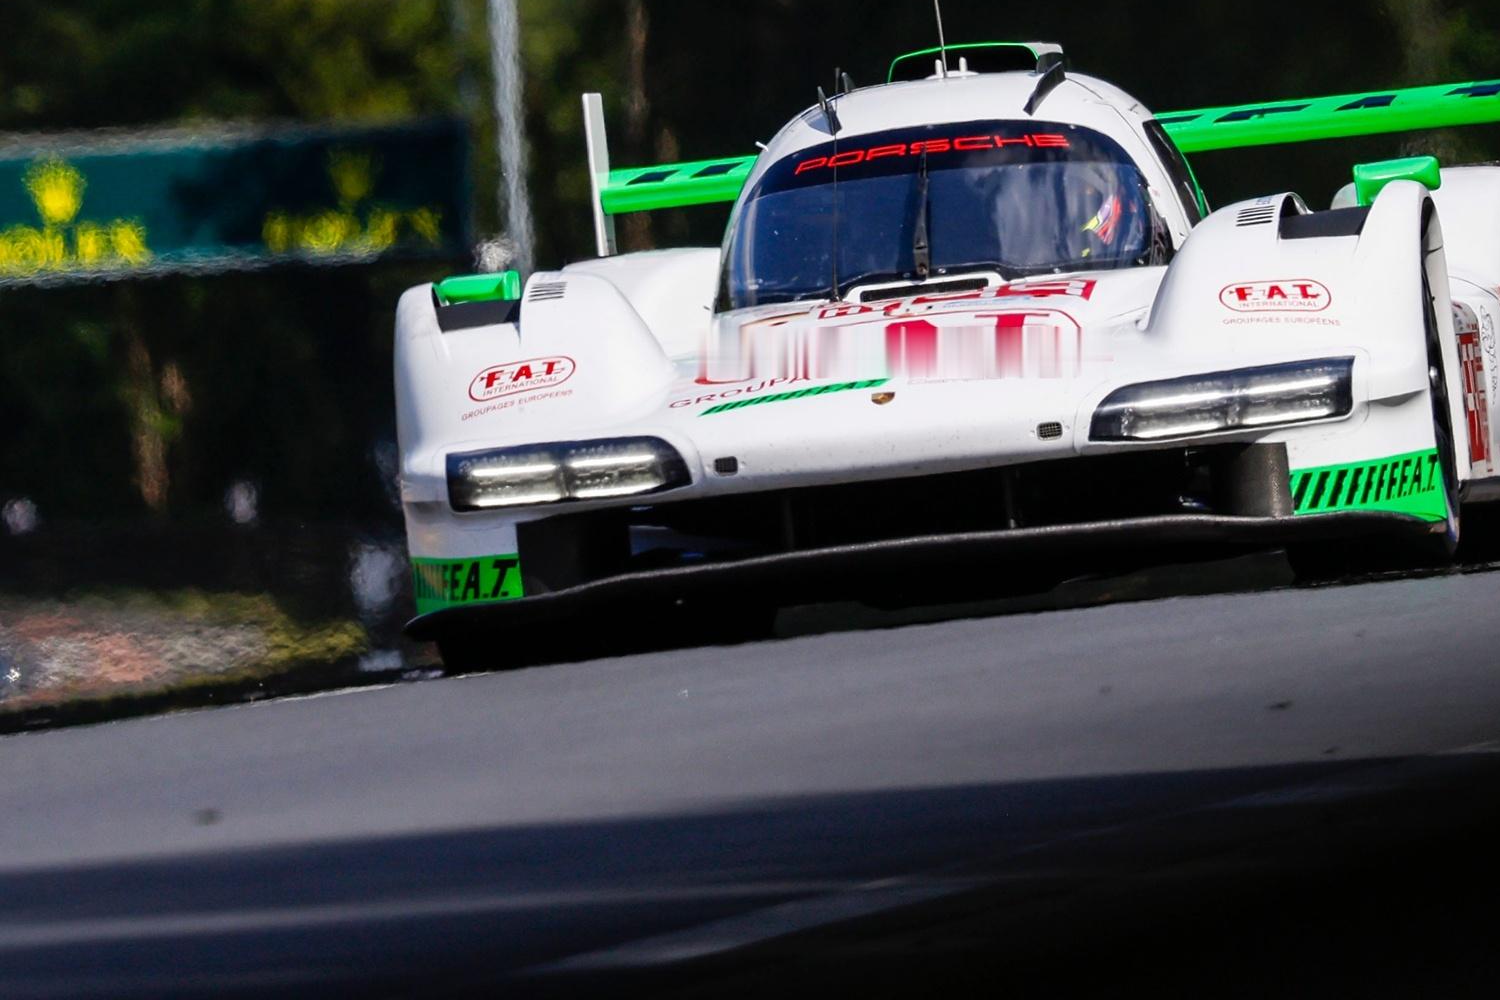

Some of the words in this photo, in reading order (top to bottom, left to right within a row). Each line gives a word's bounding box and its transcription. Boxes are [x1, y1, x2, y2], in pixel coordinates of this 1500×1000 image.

[795, 134, 1070, 175] PORSCHE
[1239, 300, 1319, 309] INTERNATIONAL
[1222, 316, 1280, 325] GROUPAGES
[483, 376, 557, 397] INTERNATIONAL
[461, 400, 515, 422] GROUPAGES
